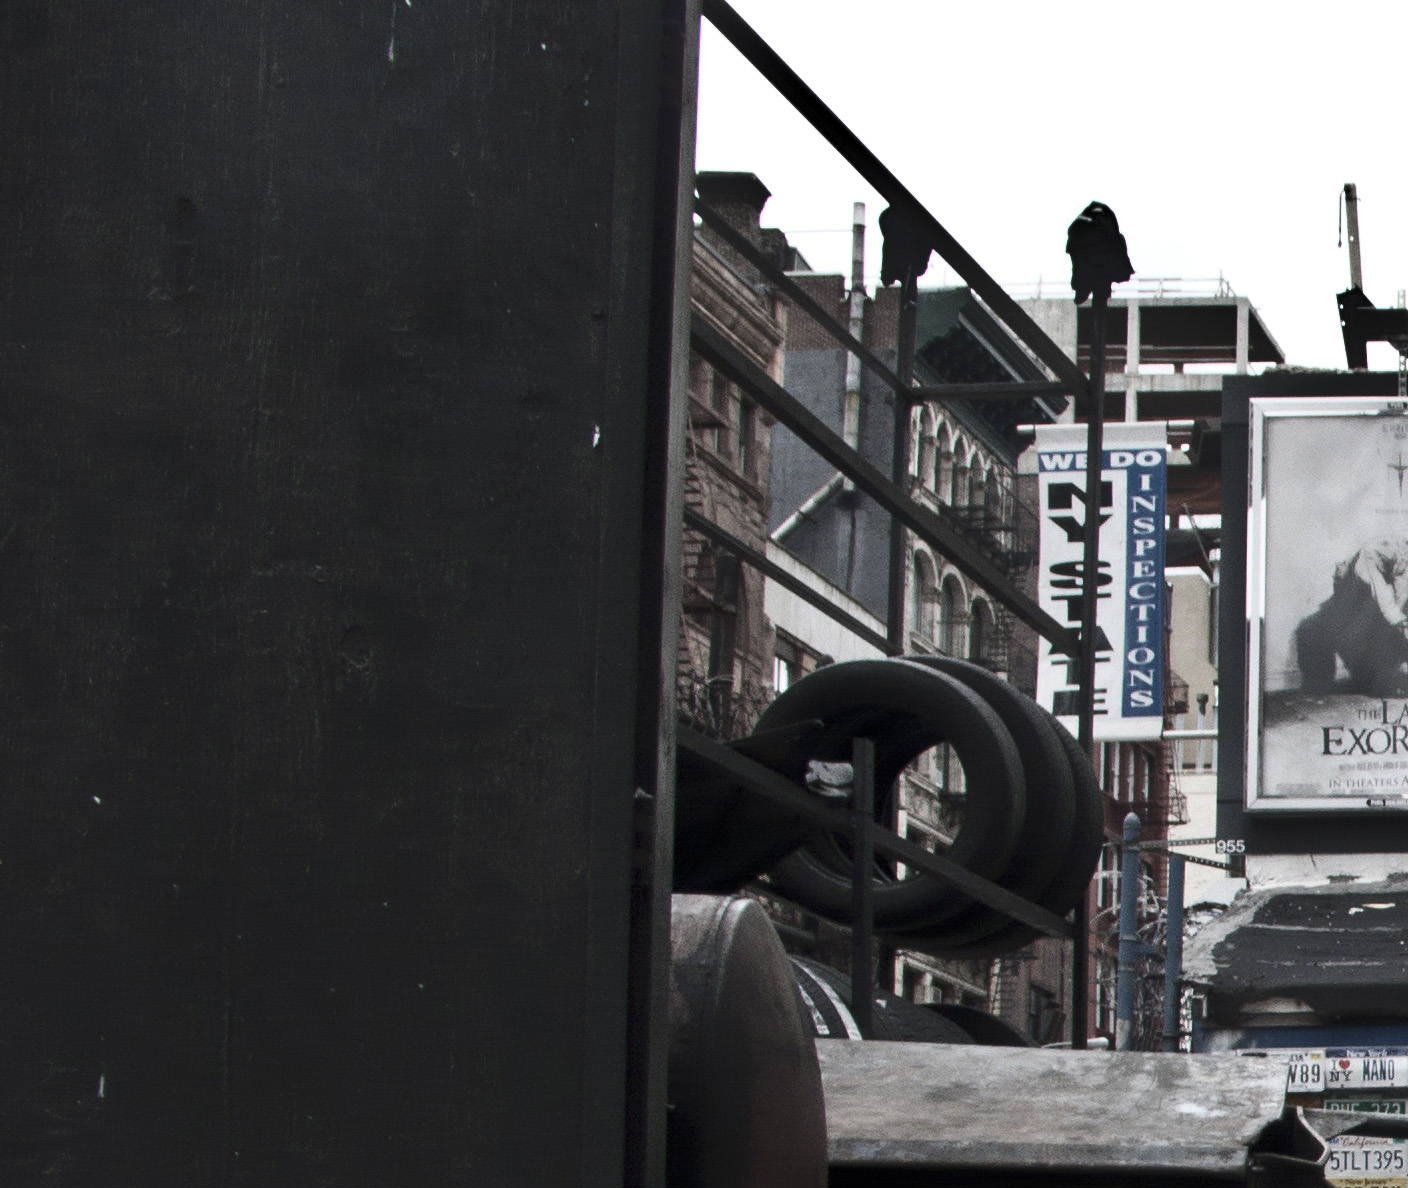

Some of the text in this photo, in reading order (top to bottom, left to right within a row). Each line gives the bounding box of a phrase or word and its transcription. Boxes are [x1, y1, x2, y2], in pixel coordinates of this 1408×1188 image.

[1040, 451, 1162, 470] WE DO
[1127, 473, 1157, 709] INSPECTIONS
[1216, 839, 1246, 853] 955
[1330, 1149, 1404, 1171] 5TLT395
